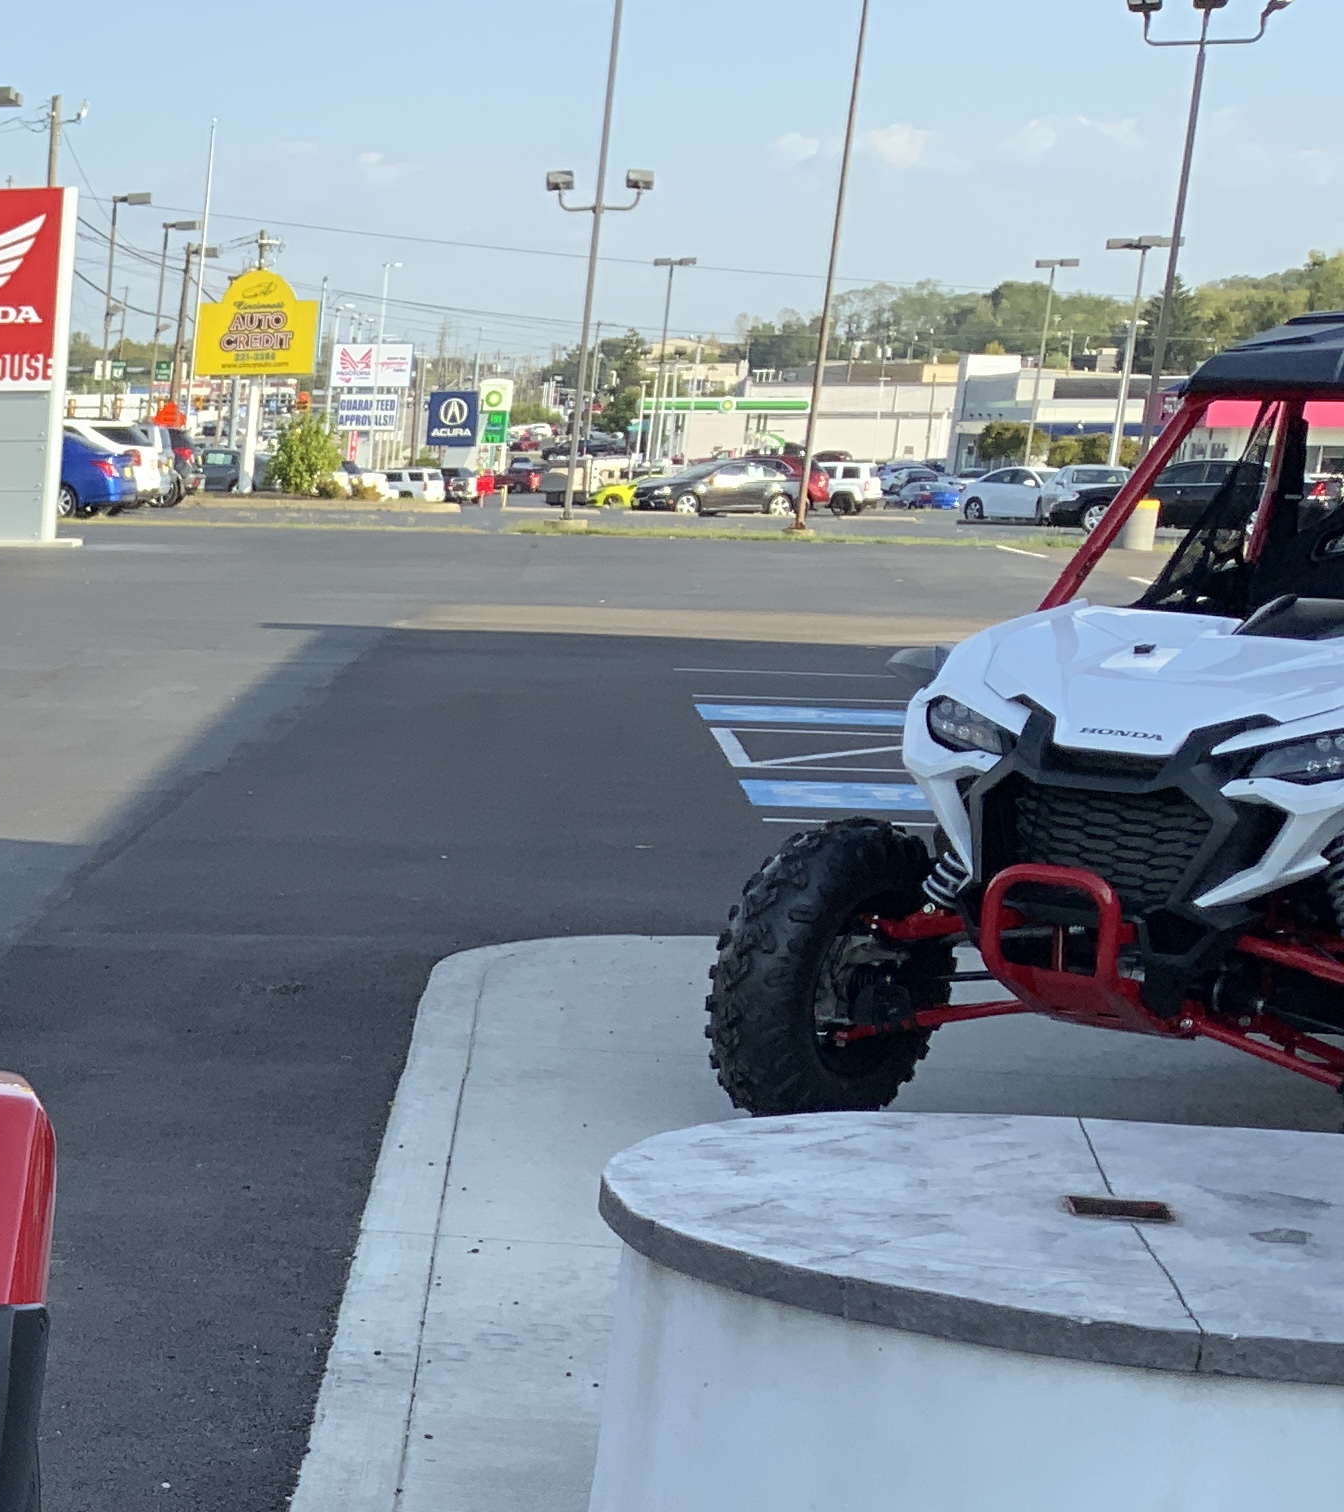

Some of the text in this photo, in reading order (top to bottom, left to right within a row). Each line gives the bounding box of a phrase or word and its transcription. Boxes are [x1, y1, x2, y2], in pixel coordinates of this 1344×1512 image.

[229, 311, 287, 331] AUTO
[220, 331, 294, 351] CREDIT
[431, 428, 471, 437] ACURA
[1080, 727, 1162, 741] HONDA
